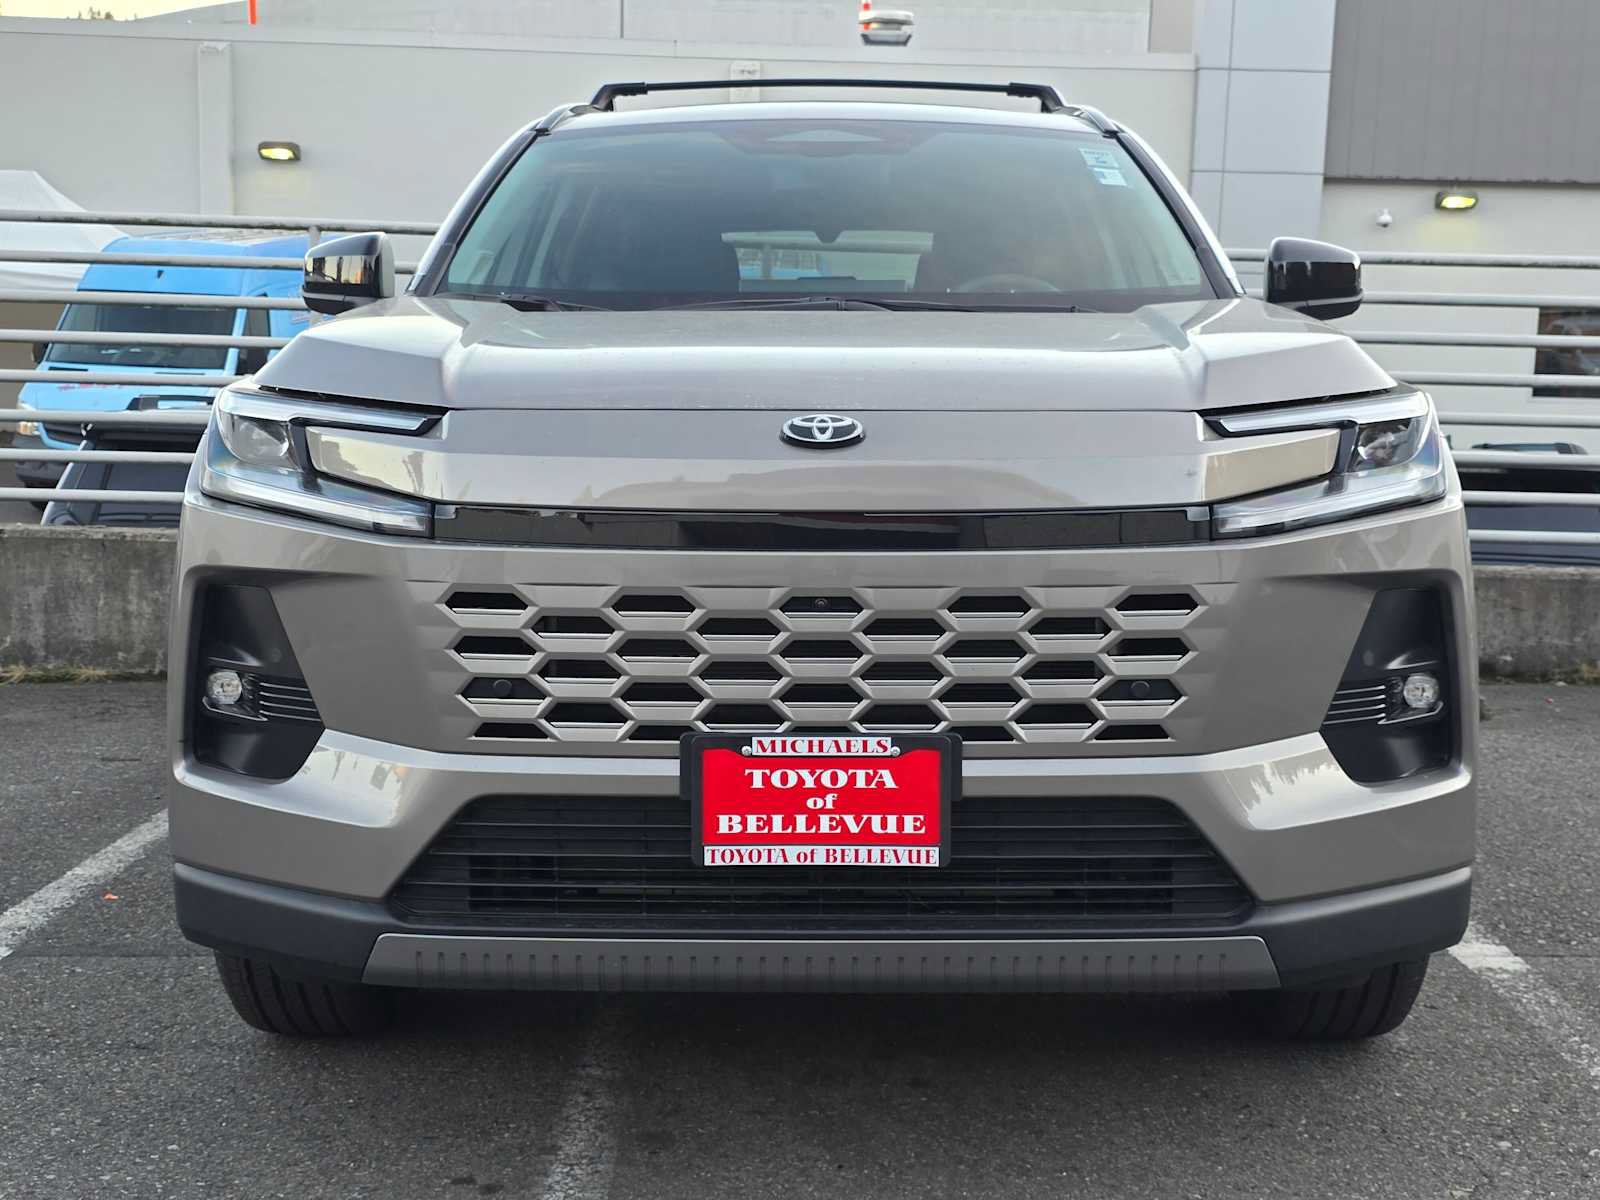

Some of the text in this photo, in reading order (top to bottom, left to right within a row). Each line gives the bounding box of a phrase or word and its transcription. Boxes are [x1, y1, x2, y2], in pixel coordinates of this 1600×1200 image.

[756, 738, 889, 754] MICHAELS
[745, 768, 897, 789] TOYOTA
[806, 794, 838, 809] of
[717, 814, 926, 834] BELLEVUE
[707, 848, 936, 865] TOYOTA of BELLEVUE
